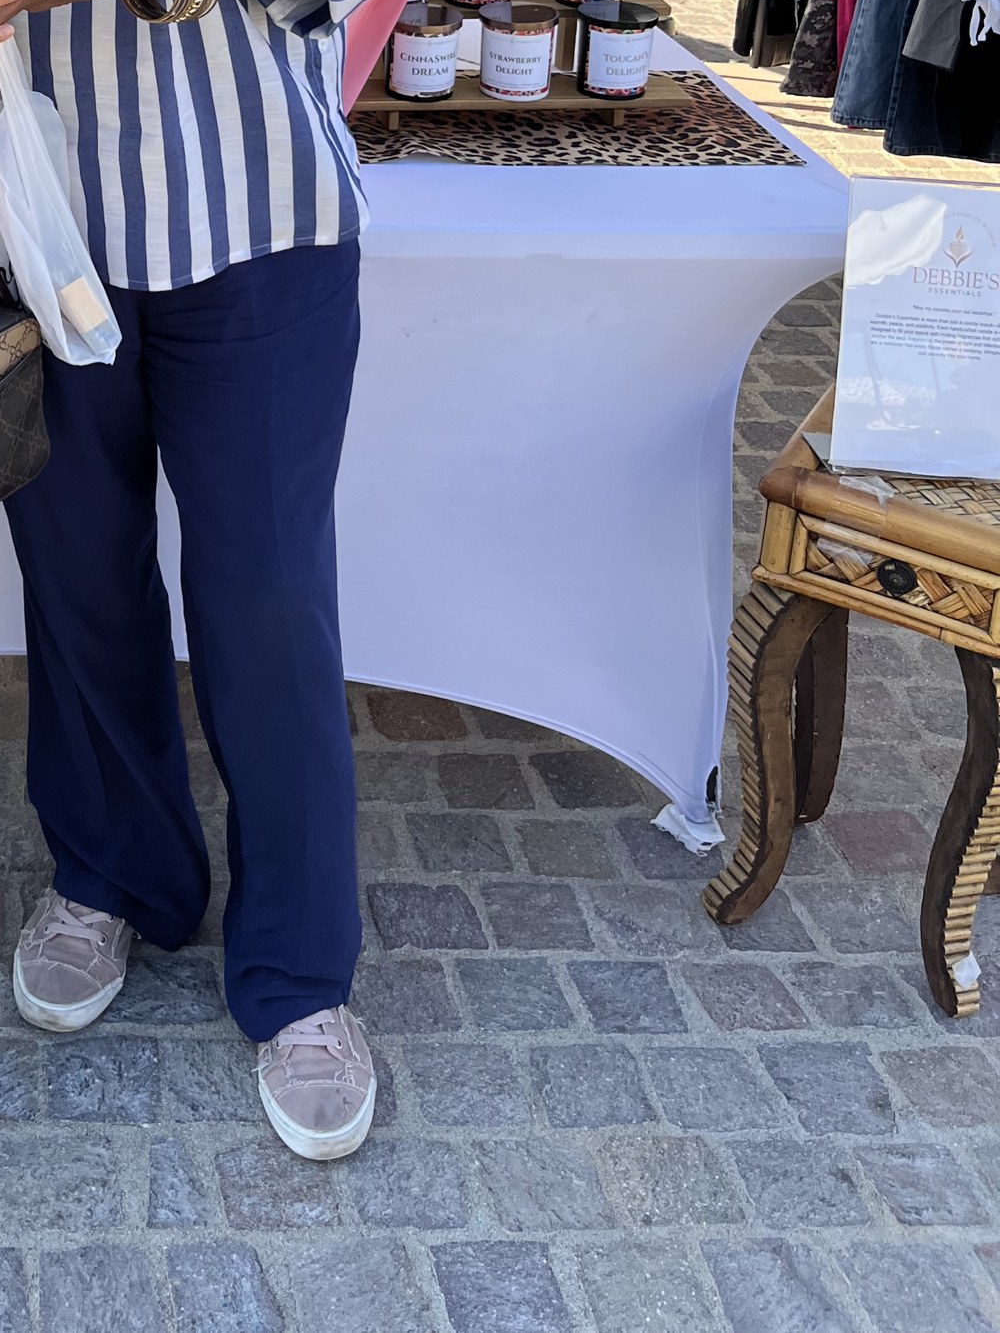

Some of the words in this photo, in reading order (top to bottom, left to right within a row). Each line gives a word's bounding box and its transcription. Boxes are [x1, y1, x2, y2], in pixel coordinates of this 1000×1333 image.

[489, 52, 541, 63] STRAWBERRY
[603, 52, 648, 62] TOUCAN'S
[412, 67, 448, 76] DREAM
[496, 65, 533, 75] DELIGHT
[606, 66, 645, 76] DELIGHT
[913, 267, 1000, 290] DEBBIE'S
[928, 288, 982, 298] ESSENTIALS
